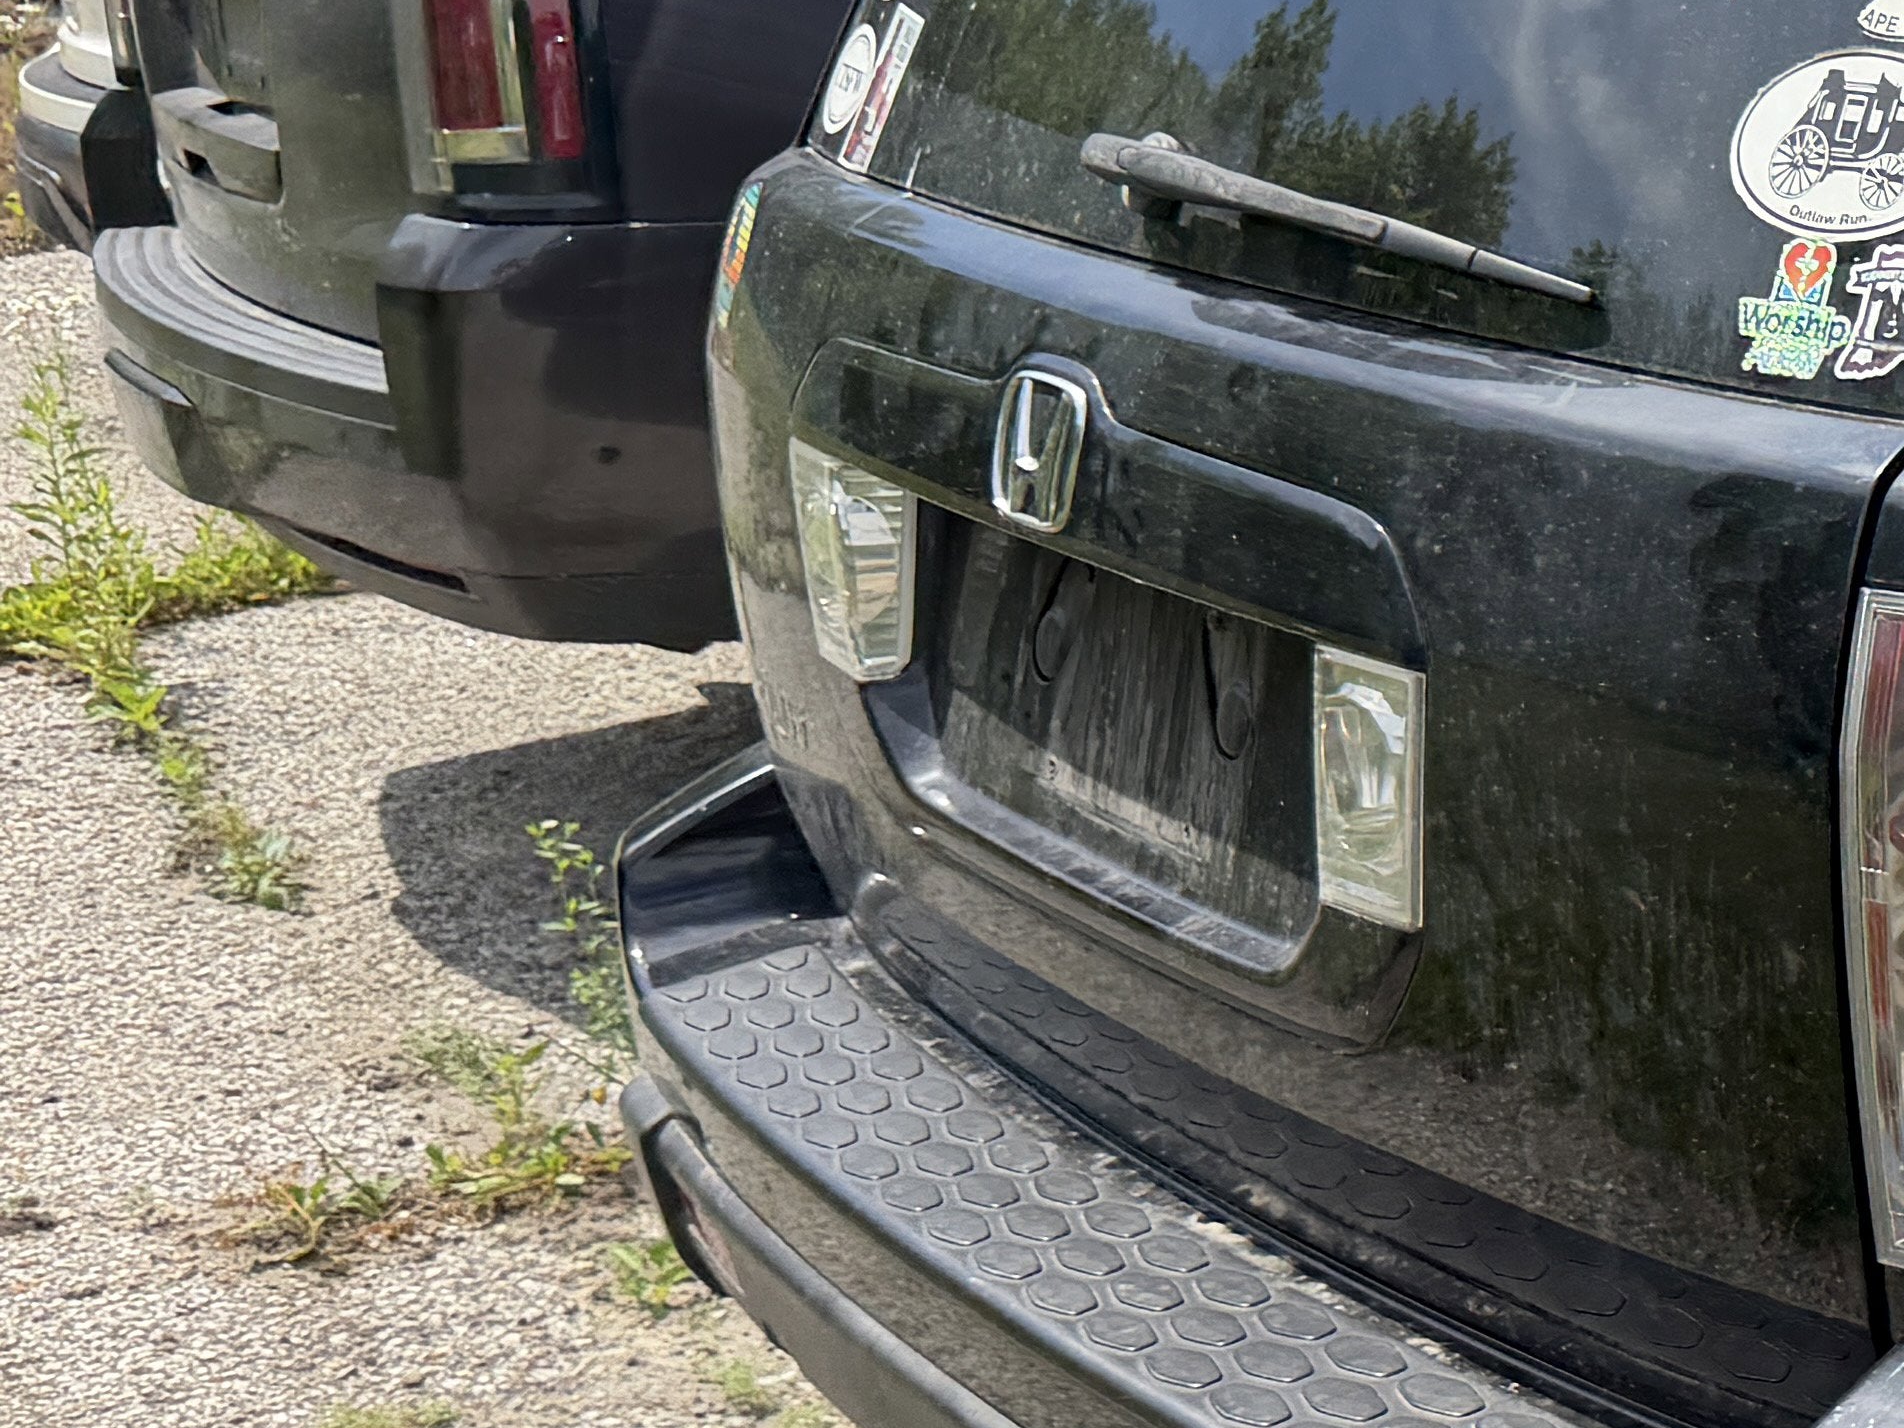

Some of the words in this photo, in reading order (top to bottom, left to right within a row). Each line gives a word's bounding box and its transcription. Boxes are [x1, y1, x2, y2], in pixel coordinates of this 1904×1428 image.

[1861, 8, 1900, 33] APE
[1789, 204, 1837, 226] Outlaw
[1839, 213, 1868, 226] Run
[1743, 301, 1847, 348] Worship
